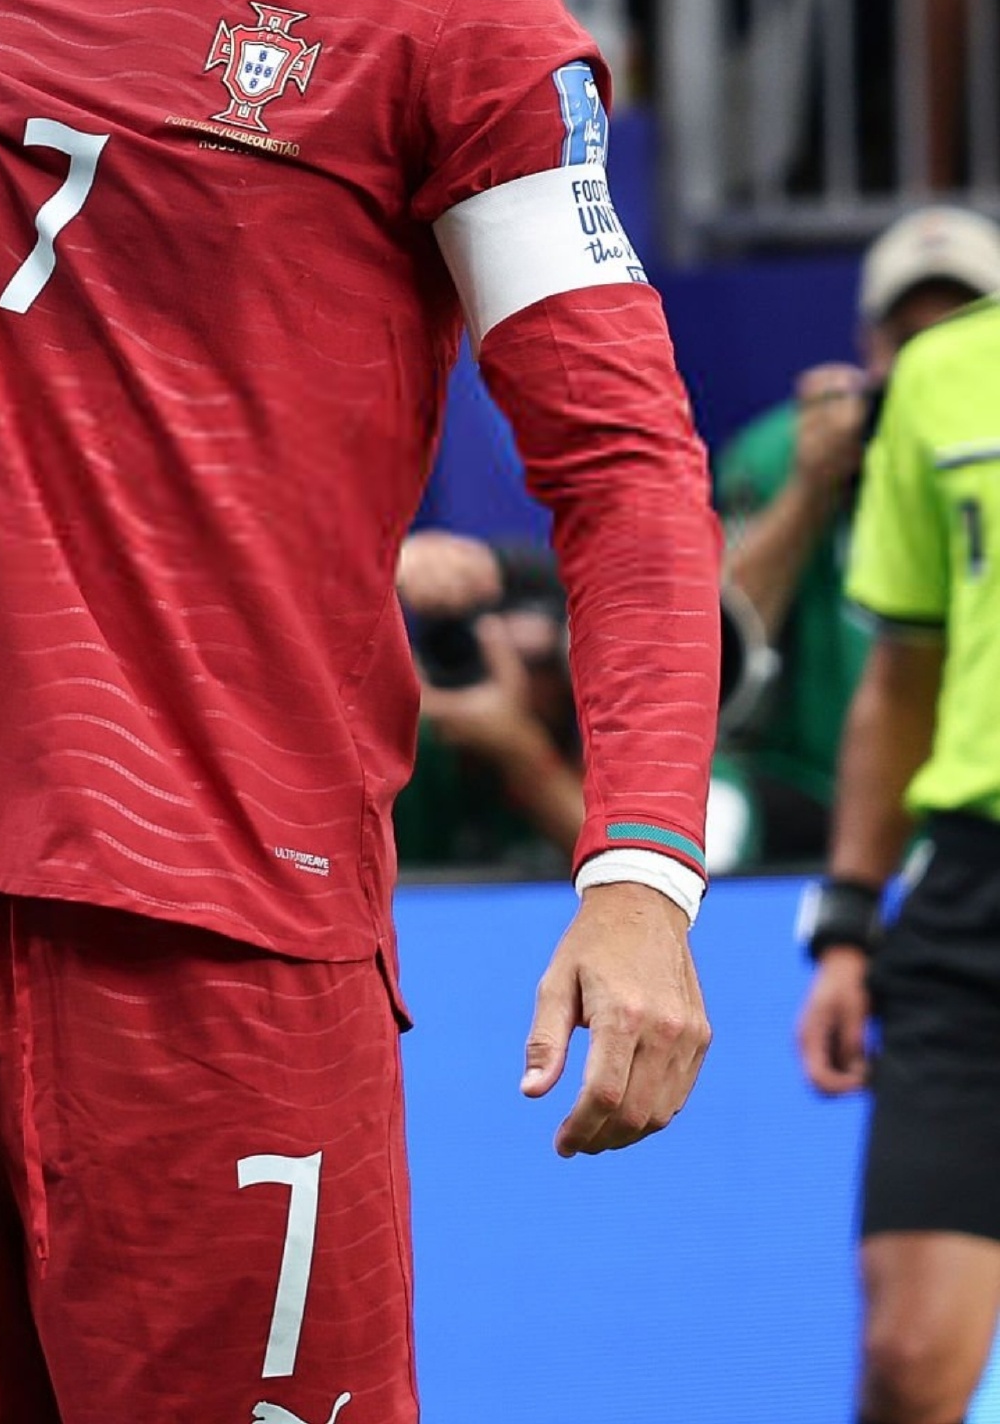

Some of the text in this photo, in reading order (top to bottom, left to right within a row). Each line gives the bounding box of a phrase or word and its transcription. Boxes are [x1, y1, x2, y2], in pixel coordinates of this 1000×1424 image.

[584, 237, 623, 264] the
[275, 846, 330, 869] ULTRAWEAVE
[237, 1150, 323, 1378] 7
